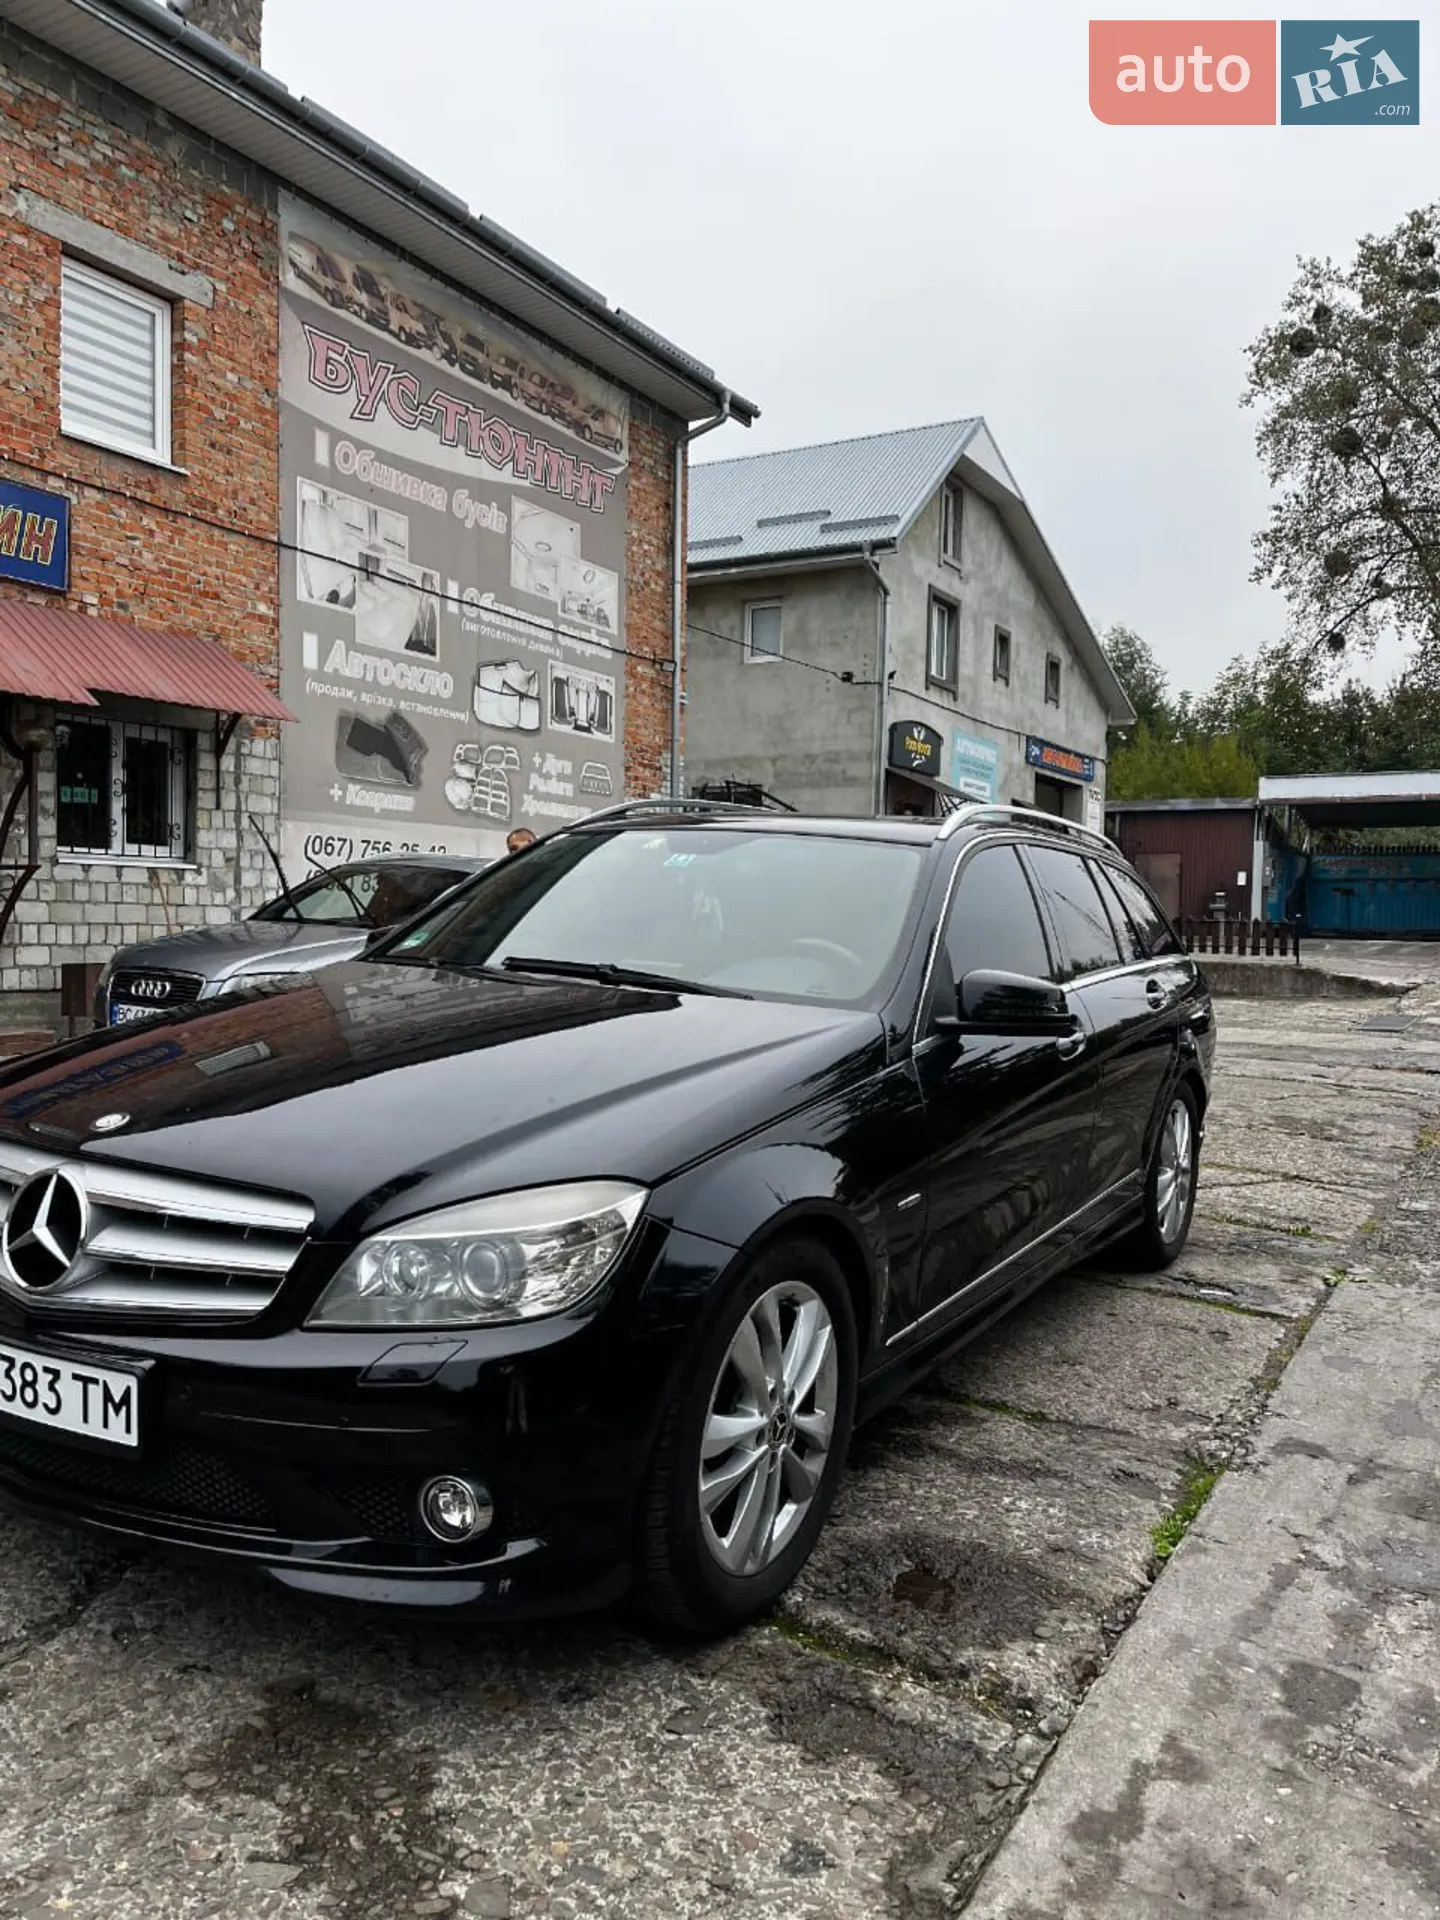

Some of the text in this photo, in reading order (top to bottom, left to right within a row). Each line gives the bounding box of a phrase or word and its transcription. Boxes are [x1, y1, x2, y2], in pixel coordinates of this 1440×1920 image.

[334, 440, 448, 512] Обшивка
[323, 638, 454, 699] Автоскло
[304, 834, 353, 863] (067)
[0, 1351, 62, 1416] 383
